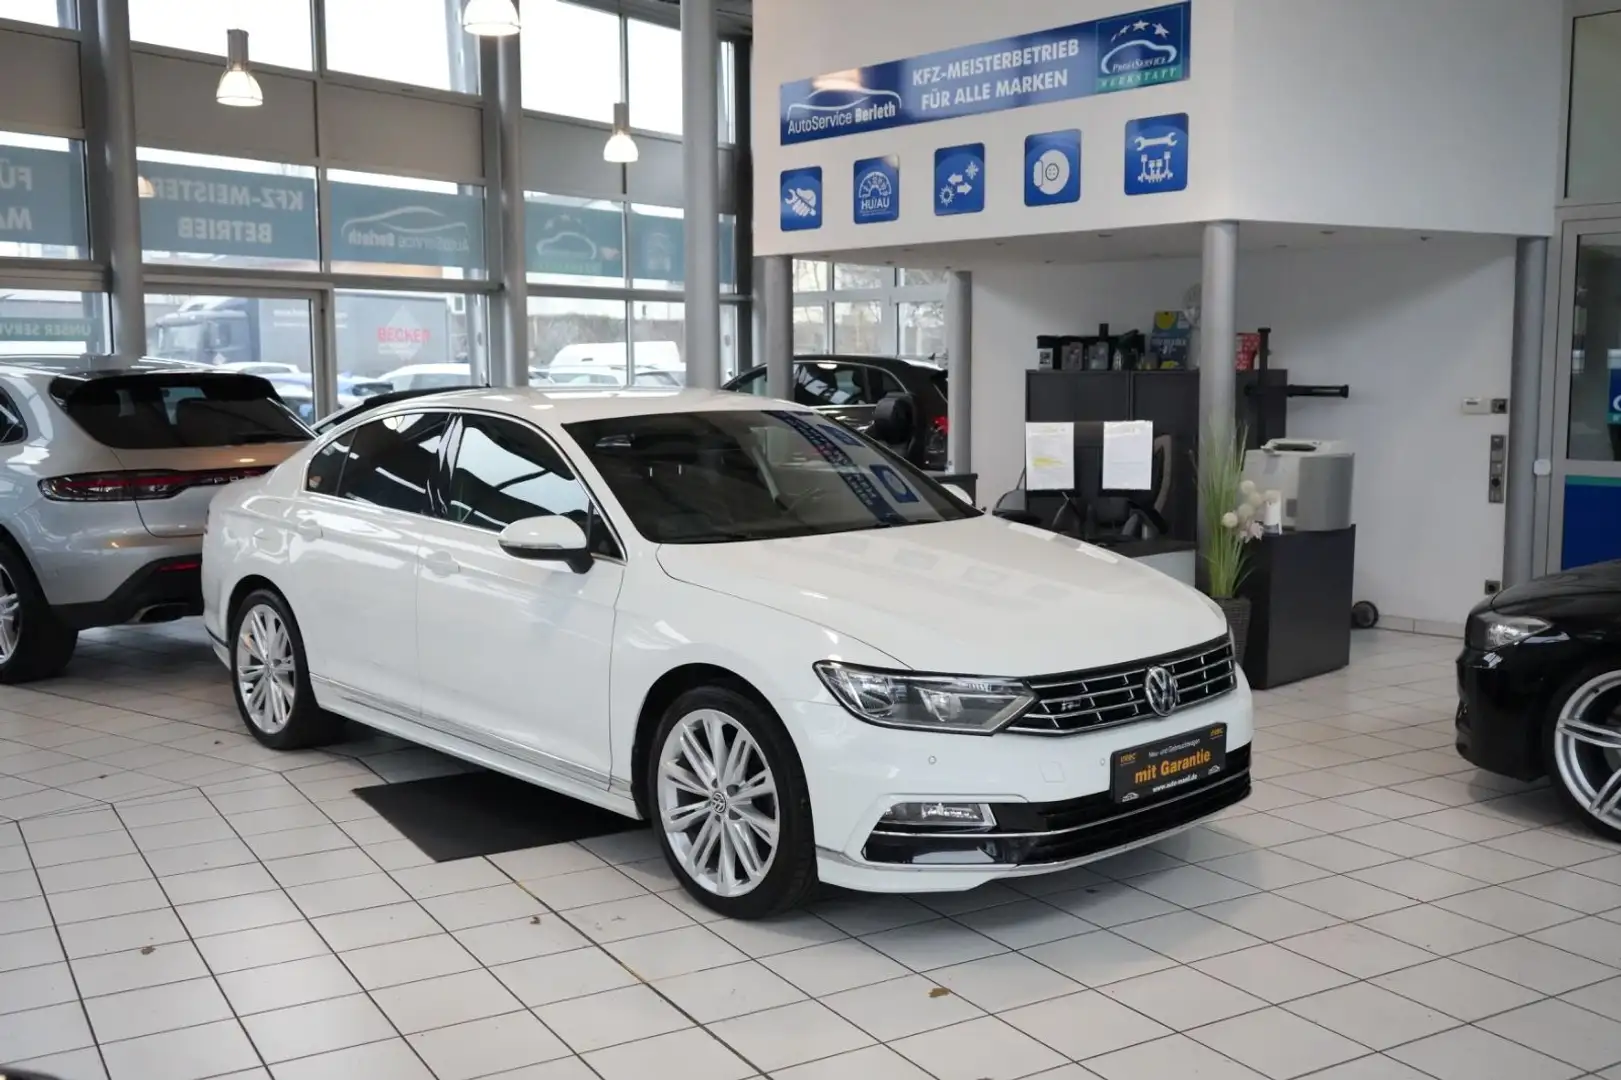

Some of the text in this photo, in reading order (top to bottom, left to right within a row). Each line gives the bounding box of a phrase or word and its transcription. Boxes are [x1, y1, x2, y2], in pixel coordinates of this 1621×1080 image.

[912, 38, 1079, 87] KFZ-MEISTERBETRIEB
[921, 68, 1069, 111] FÜR ALLE MARKEN
[787, 101, 896, 135] AutoService Berleth
[861, 196, 890, 211] HU/AU
[1135, 763, 1157, 784] mit
[1161, 748, 1212, 777] Garantie
